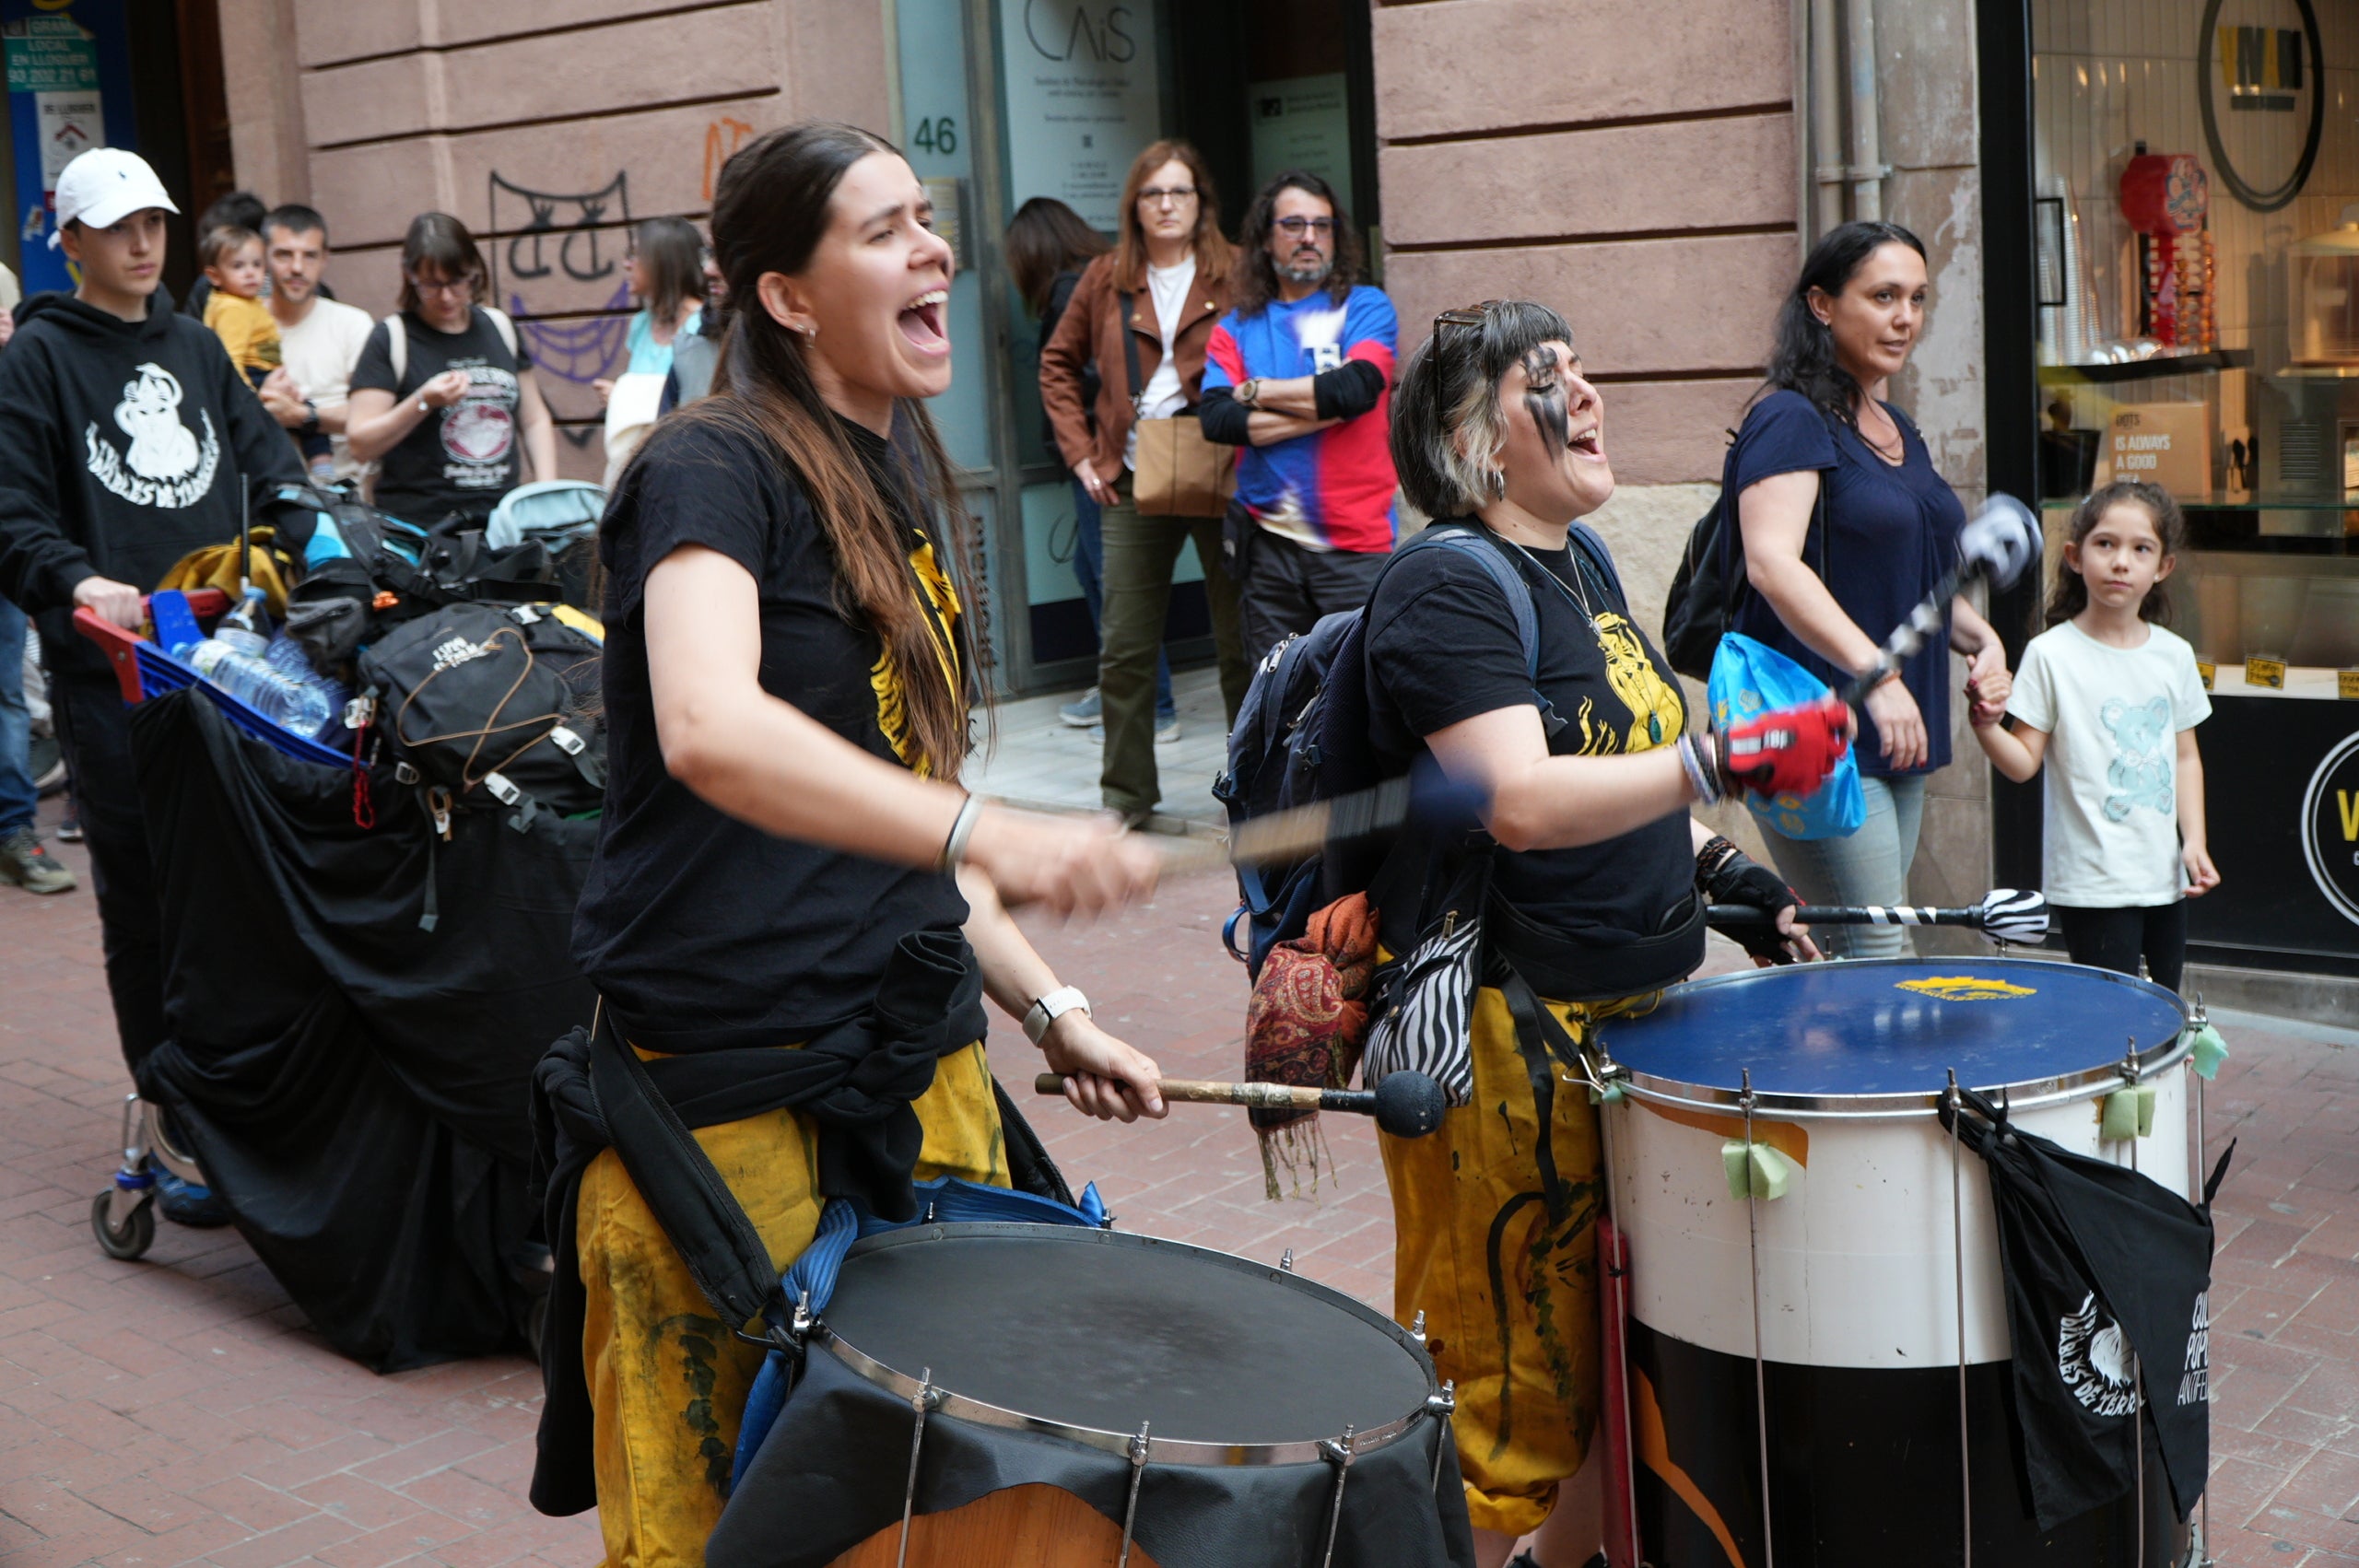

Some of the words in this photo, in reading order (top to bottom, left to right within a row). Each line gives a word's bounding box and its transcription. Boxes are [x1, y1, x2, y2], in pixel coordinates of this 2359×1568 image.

[914, 117, 957, 155] 46
[2116, 435, 2126, 451] IS
[2128, 434, 2171, 451] ALWAYS
[2116, 454, 2125, 470] A
[2127, 453, 2157, 470] GOOD
